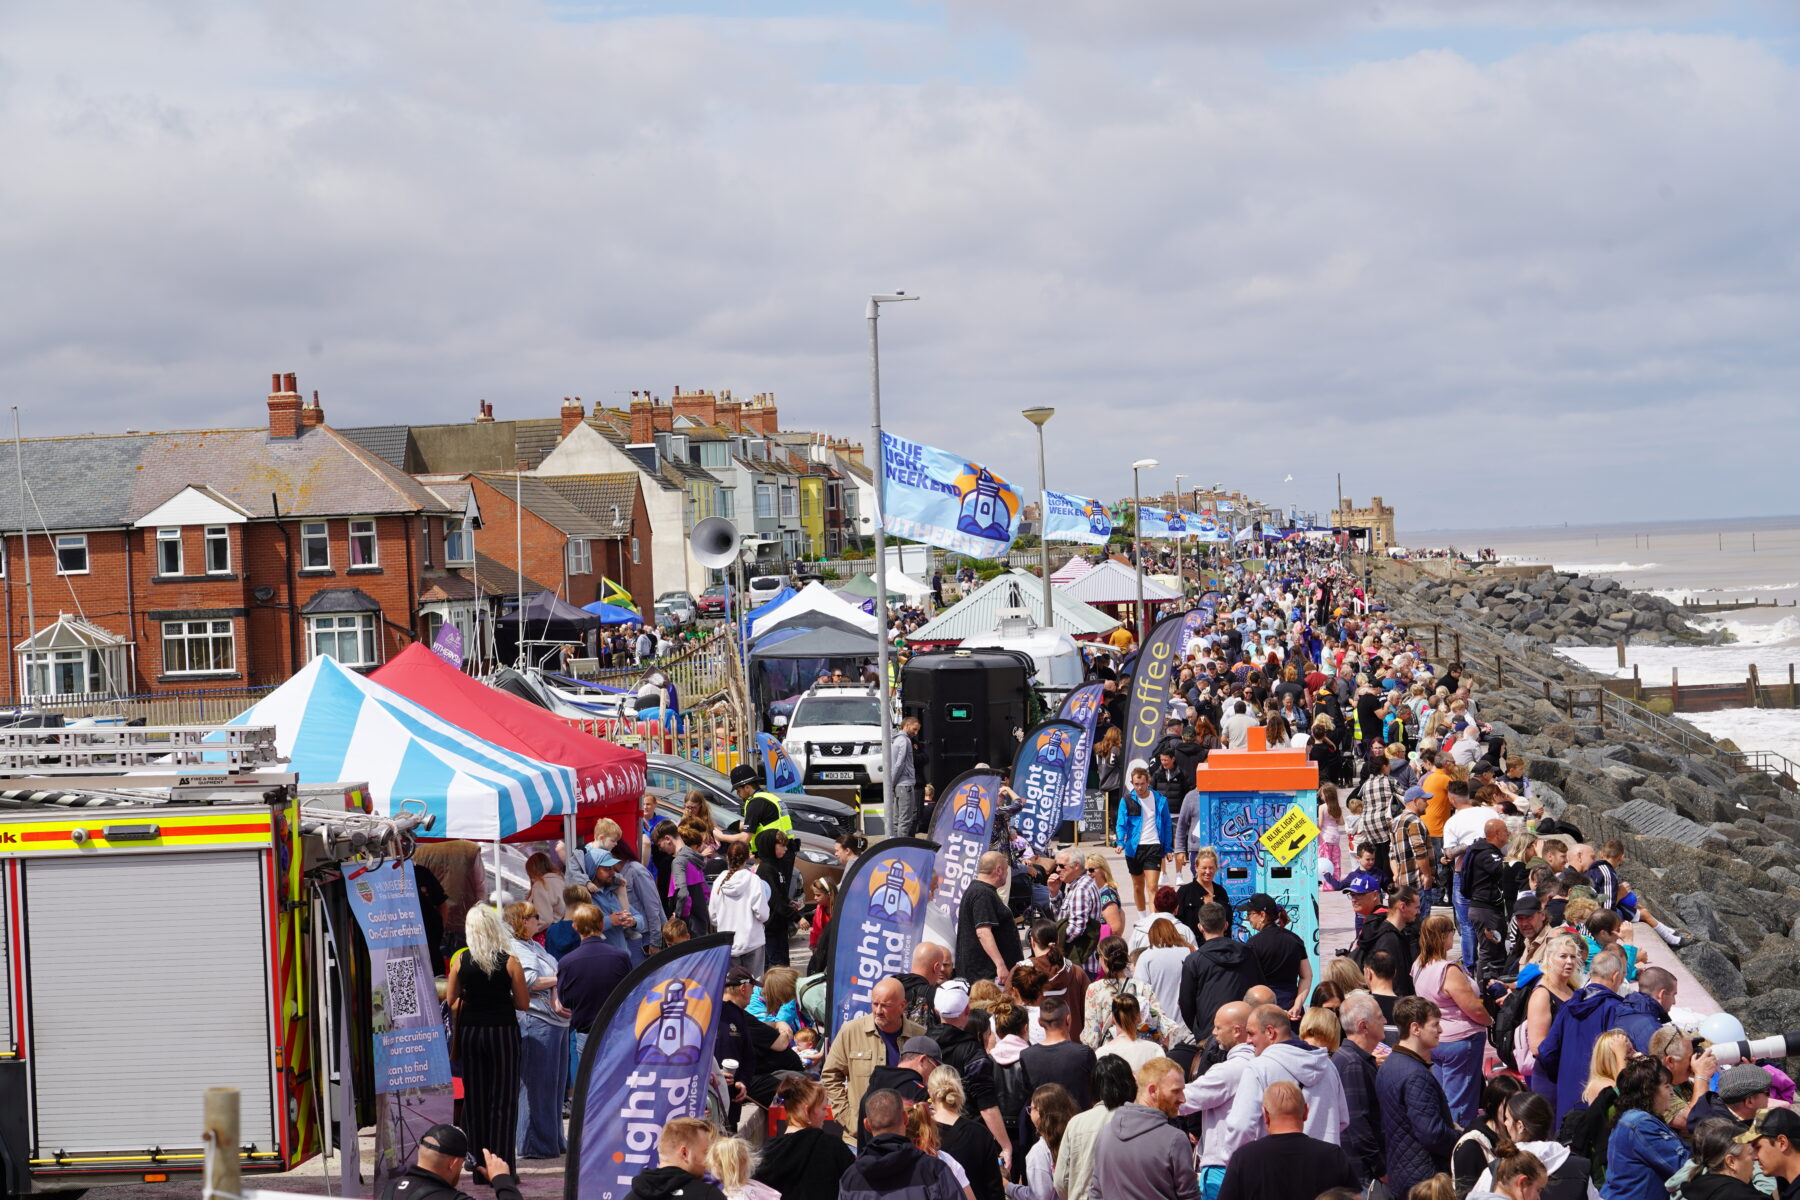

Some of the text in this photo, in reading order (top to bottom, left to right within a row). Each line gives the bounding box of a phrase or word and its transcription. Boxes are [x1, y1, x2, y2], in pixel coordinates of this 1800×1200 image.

[882, 432, 922, 461] BLUE
[885, 446, 929, 472] LIGHT
[886, 463, 962, 498] WEEKEND
[1133, 642, 1170, 747] Coffee
[1022, 765, 1043, 814] Light
[1266, 812, 1297, 842] BLUE LIGHT
[1271, 828, 1295, 851] DONATIONS
[1293, 818, 1306, 830] HERE
[938, 833, 963, 898] Light
[368, 911, 387, 923] Could
[398, 909, 408, 919] be
[851, 921, 882, 1003] Light
[903, 935, 912, 970] services
[395, 1030, 432, 1043] recruiting
[432, 1028, 439, 1038] in
[405, 1045, 426, 1053] area.
[389, 1074, 427, 1086] out more.
[404, 1064, 412, 1073] to
[414, 1060, 429, 1071] find
[688, 1074, 699, 1118] ervices
